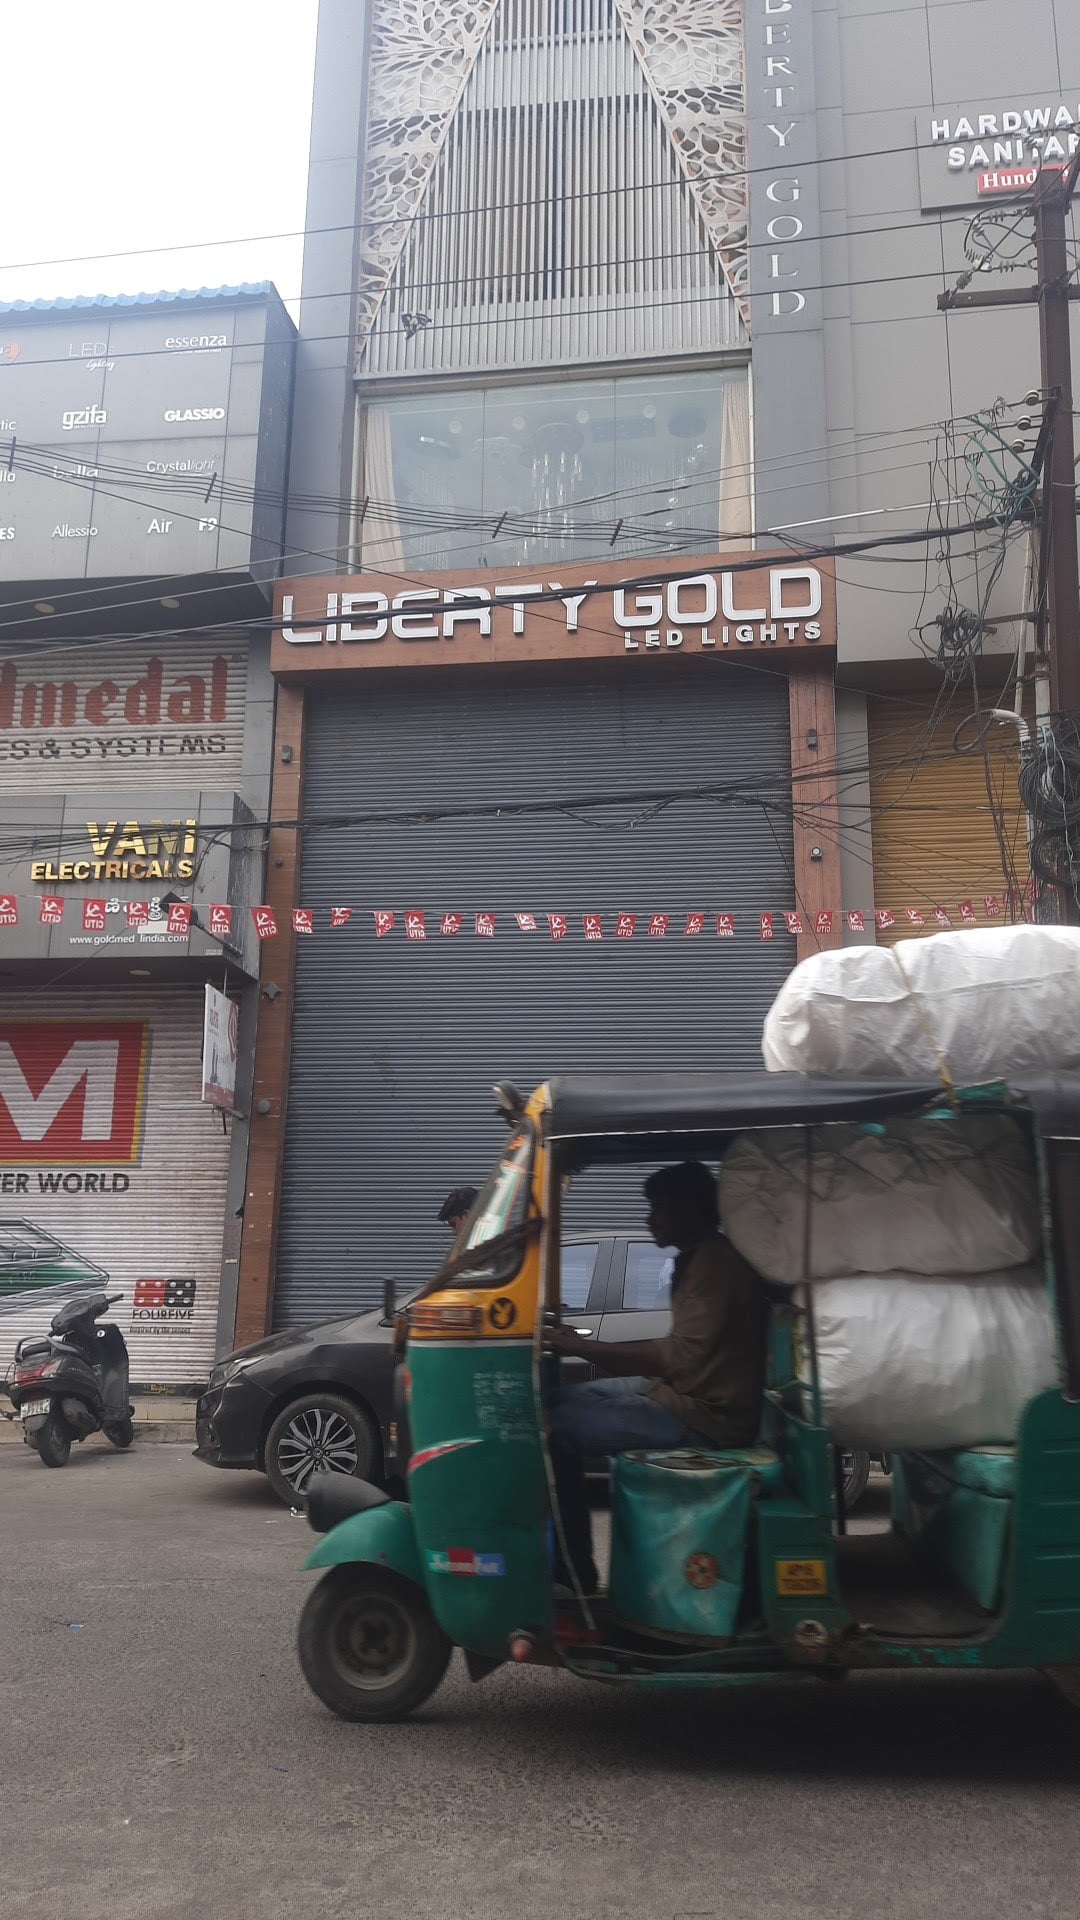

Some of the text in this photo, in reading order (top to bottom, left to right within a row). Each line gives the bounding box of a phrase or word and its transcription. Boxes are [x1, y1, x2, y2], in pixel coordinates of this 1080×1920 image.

[931, 103, 1080, 140] HARDWA
[766, 178, 807, 317] GOLD
[165, 335, 227, 348] essenza
[61, 404, 107, 430] gzifa
[164, 407, 225, 422] GLASSIO
[51, 524, 98, 538] Allessio
[147, 518, 172, 534] Air
[281, 567, 822, 643] LIBERTY GOLD
[624, 621, 821, 649] LED LIGHTS
[39, 738, 61, 760] &
[70, 733, 227, 759] SYSTEMS
[86, 818, 198, 856] VANI
[30, 859, 194, 881] ELECTRICALS
[38, 1173, 130, 1194] WORLD
[132, 1309, 195, 1320] FOURFIVE
